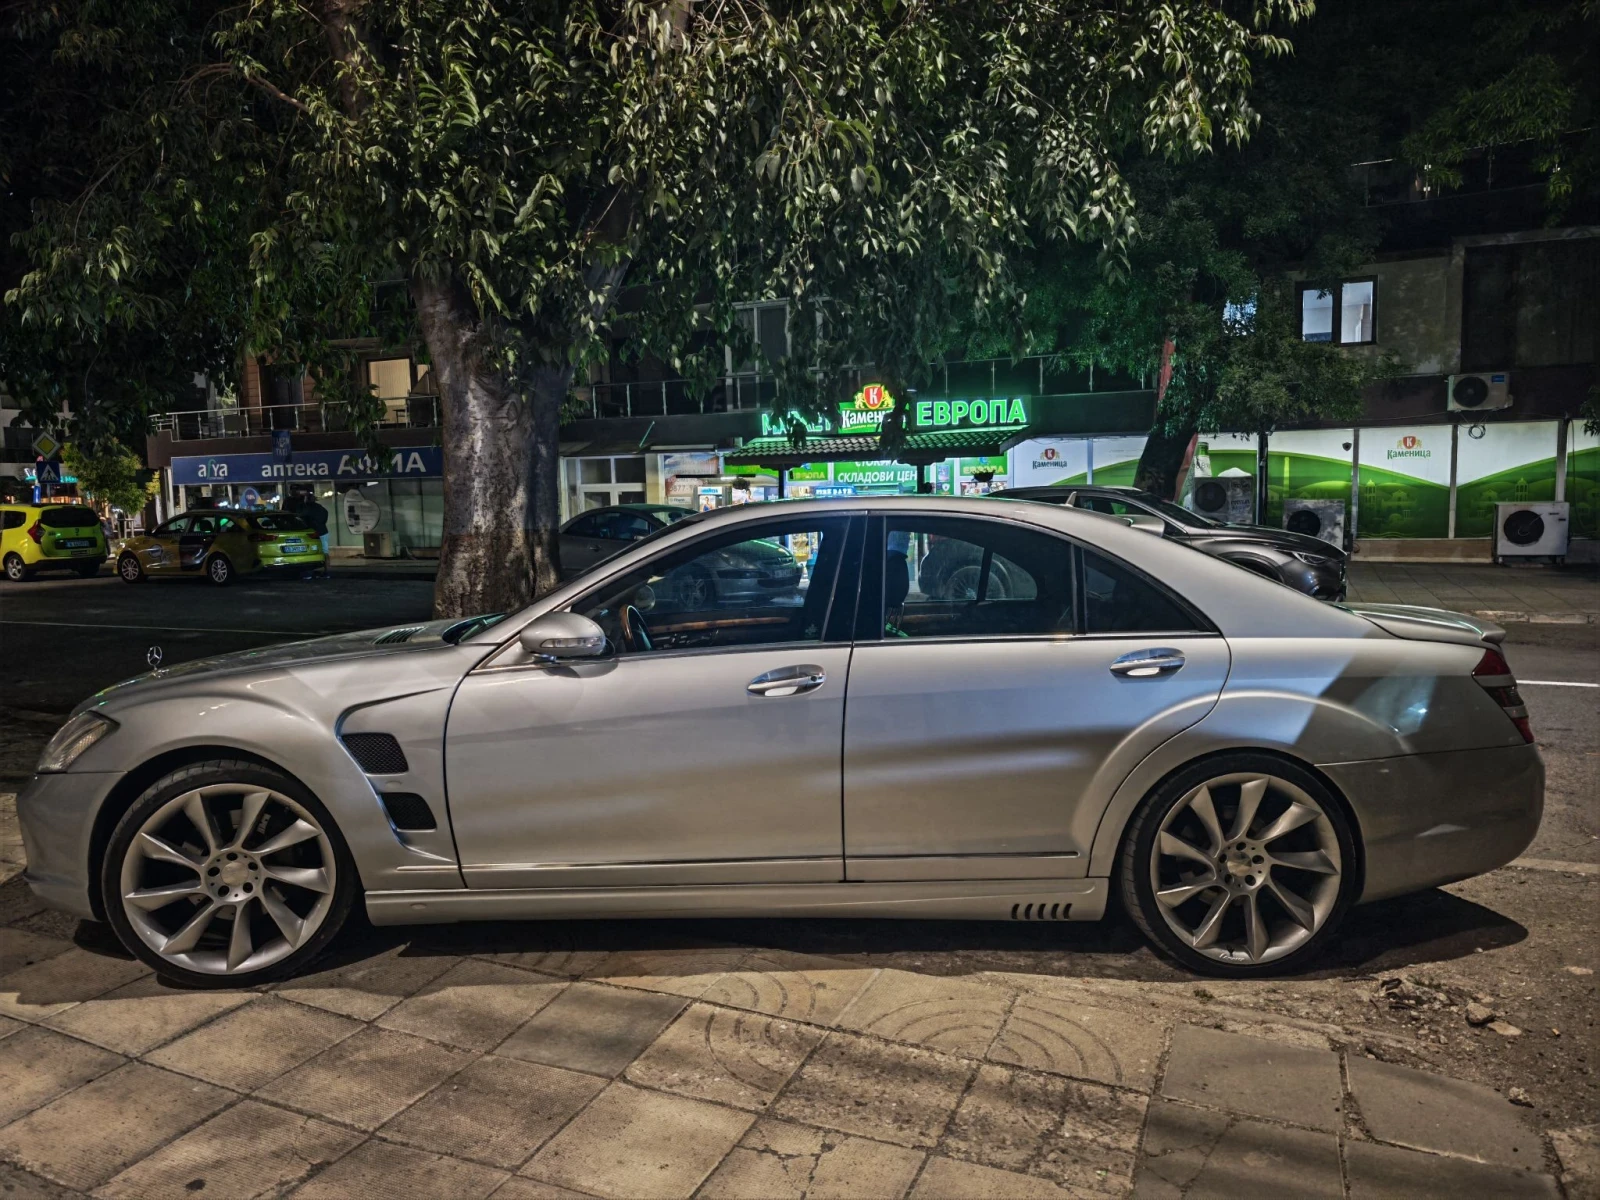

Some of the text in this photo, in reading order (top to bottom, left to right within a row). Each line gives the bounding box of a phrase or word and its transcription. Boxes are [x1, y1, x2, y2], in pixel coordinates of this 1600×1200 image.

[842, 409, 888, 428] Камен
[916, 399, 1026, 426] ЕВРОПА
[1387, 449, 1431, 460] Каменица
[261, 462, 328, 477] аптека
[1032, 460, 1068, 470] Каменица
[837, 471, 917, 484] СКЛАДОВИ ЦЕН
